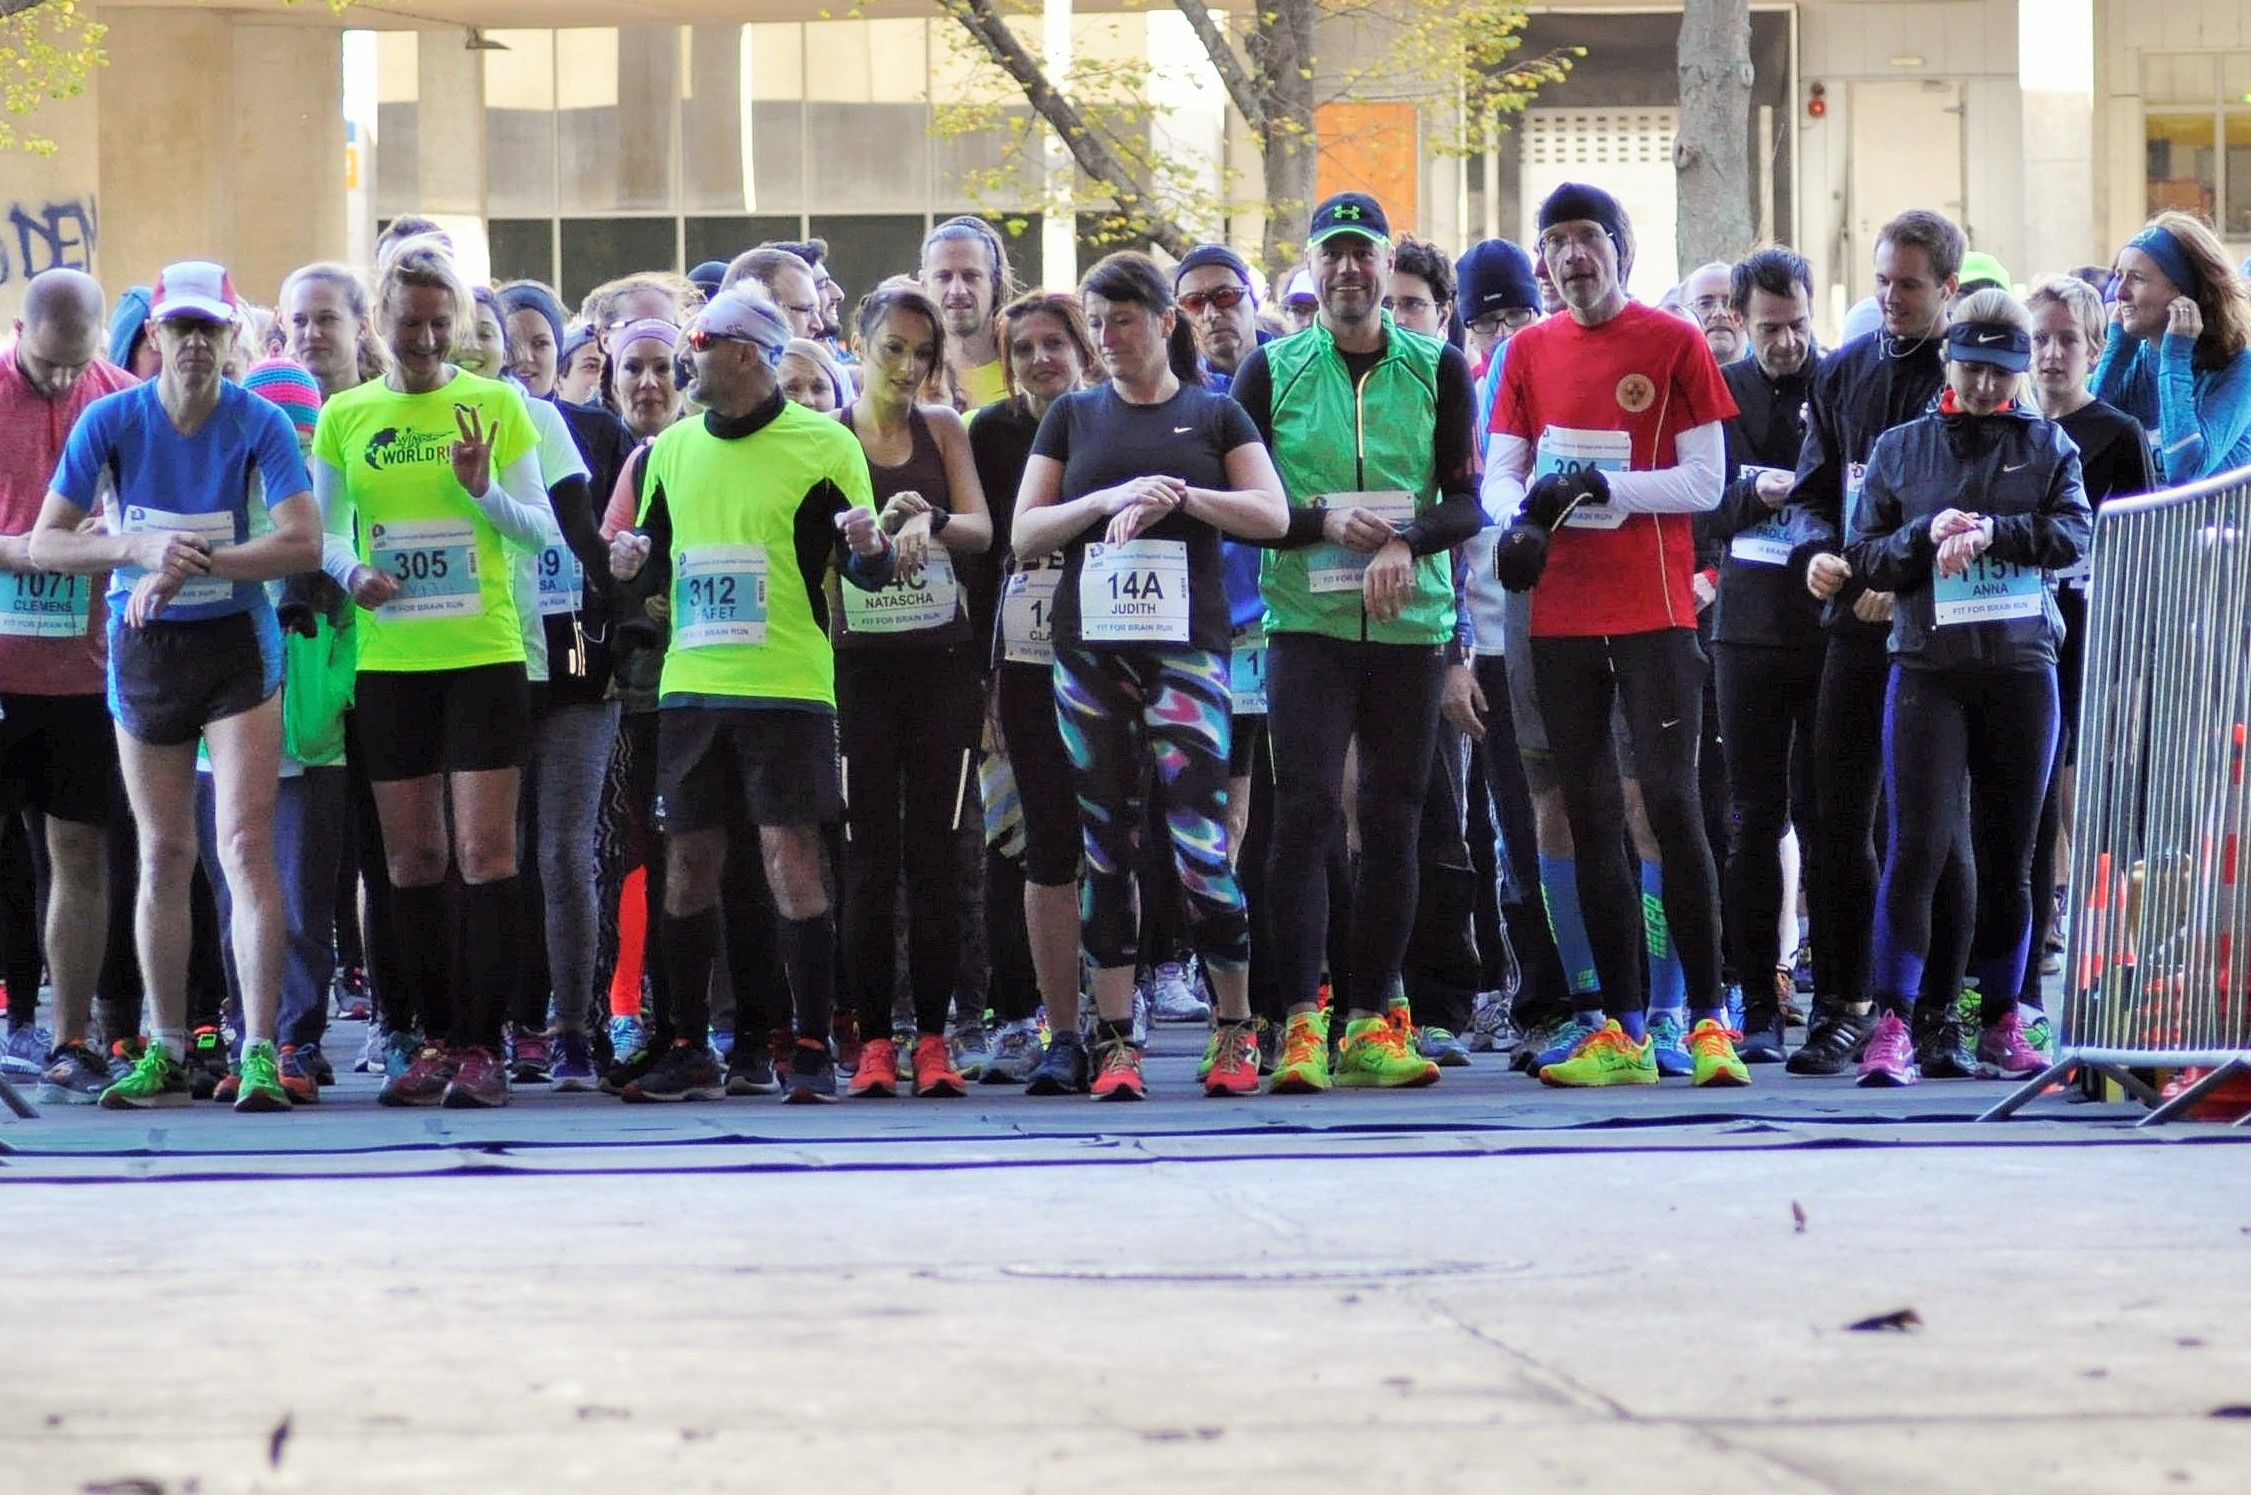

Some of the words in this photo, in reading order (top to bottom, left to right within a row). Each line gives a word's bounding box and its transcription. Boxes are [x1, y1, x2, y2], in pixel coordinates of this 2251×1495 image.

[383, 448, 435, 464] WORLD
[394, 549, 448, 581] 305
[13, 570, 75, 597] 1071
[689, 576, 736, 606] 312
[1107, 571, 1165, 600] 14A
[1972, 583, 2010, 596] ANNA
[13, 600, 73, 613] CLEMENS
[865, 592, 934, 609] NATASCHA
[1967, 605, 1986, 613] FOR
[1987, 603, 2012, 611] BRAIN
[1111, 603, 1157, 615] JUDITH
[1110, 624, 1126, 632] FOR
